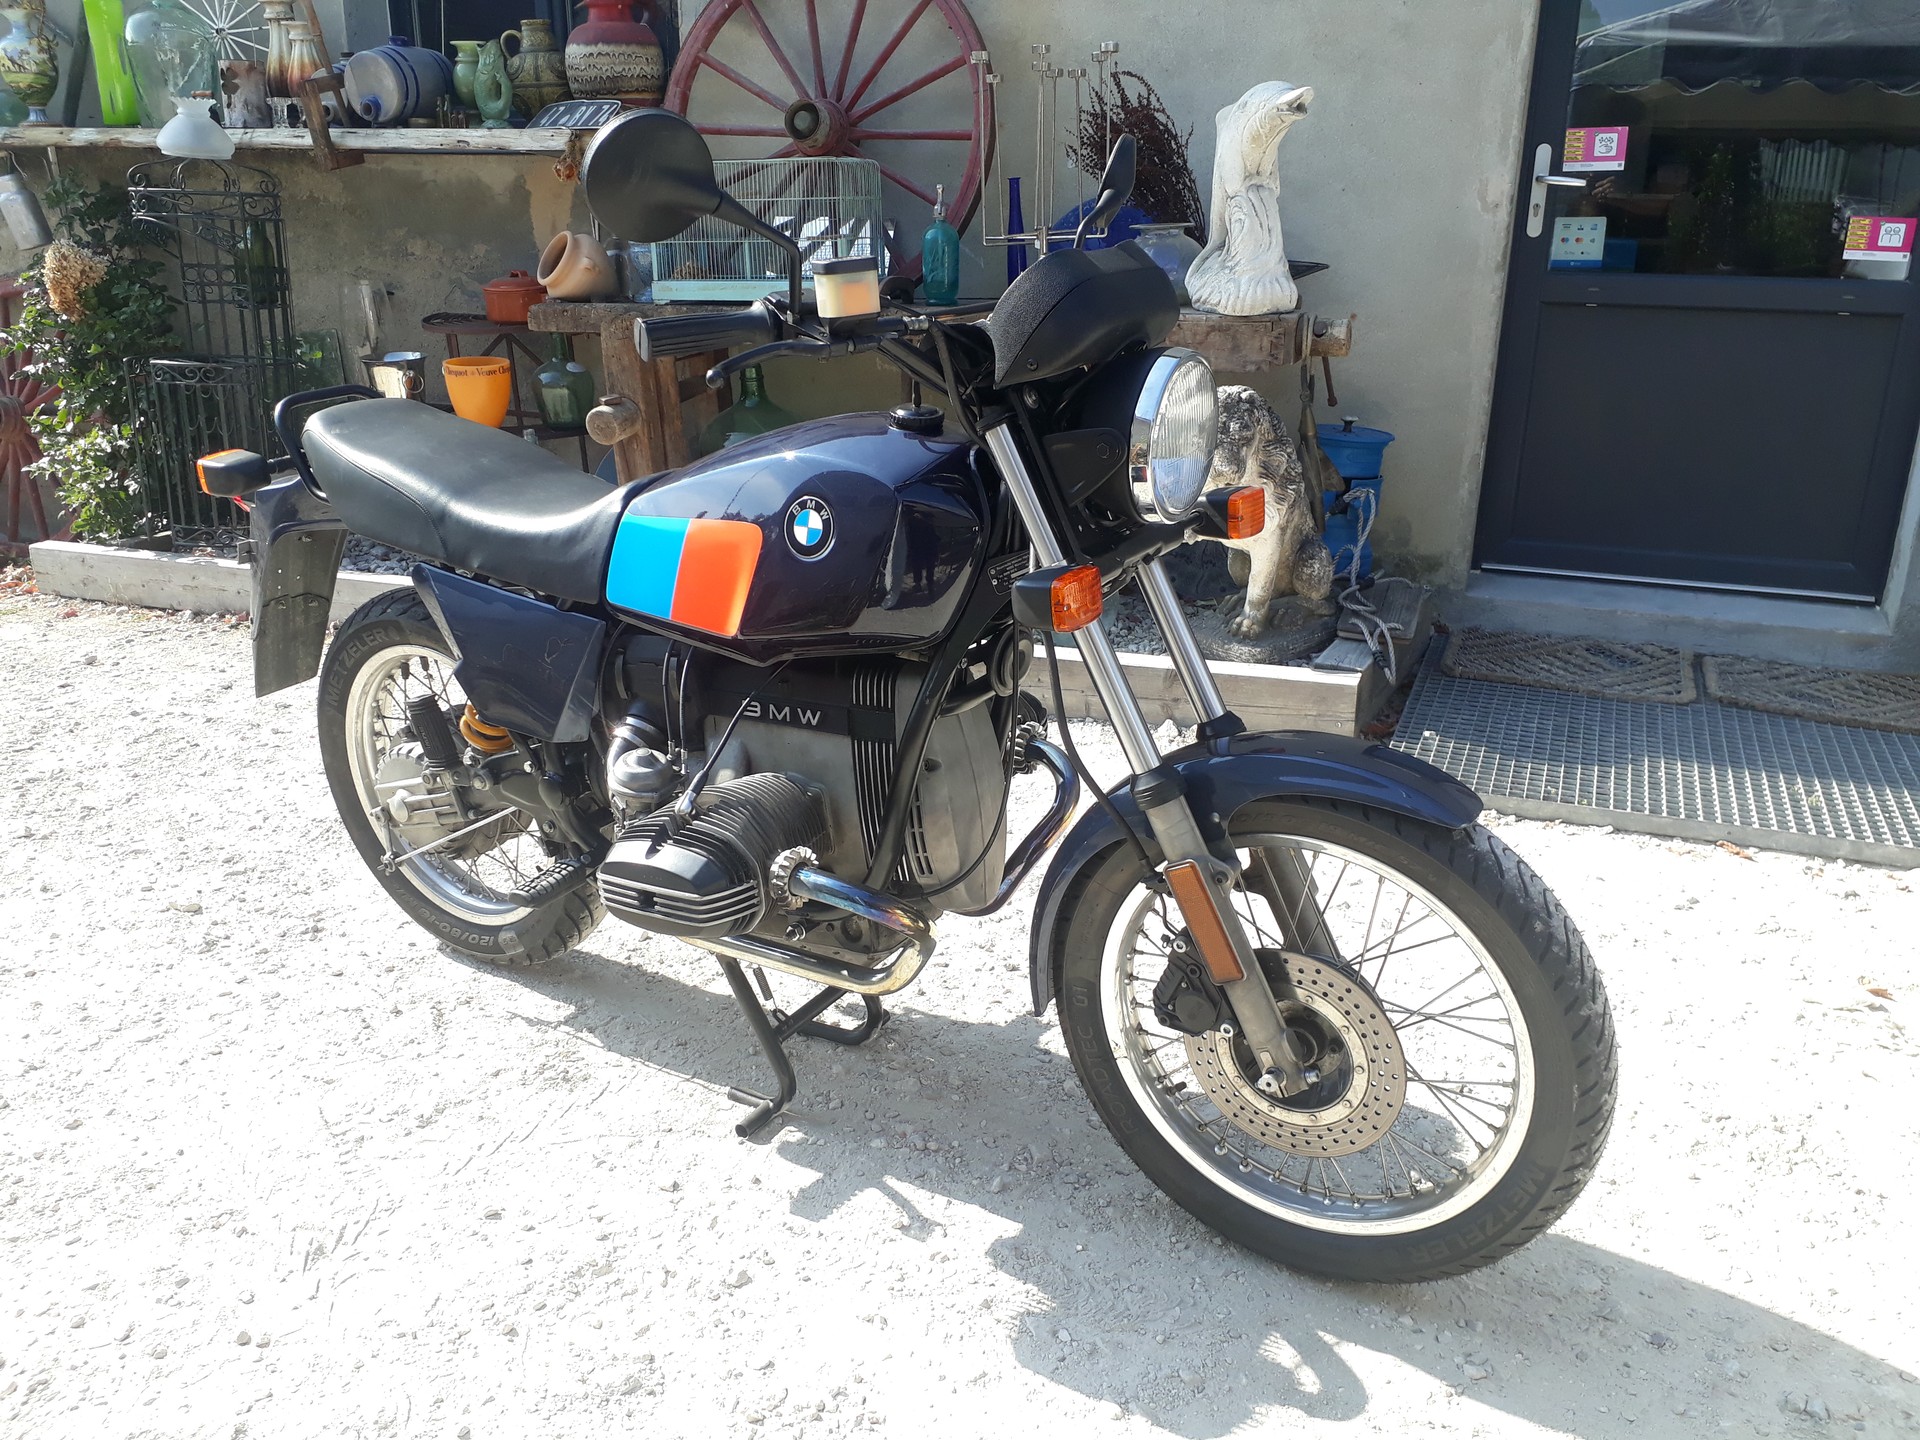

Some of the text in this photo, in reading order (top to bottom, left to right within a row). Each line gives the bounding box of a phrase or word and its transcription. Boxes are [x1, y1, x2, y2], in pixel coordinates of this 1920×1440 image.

[792, 499, 830, 520] BMW
[327, 627, 386, 706] METZELER
[1077, 1024, 1138, 1136] ROADTEC
